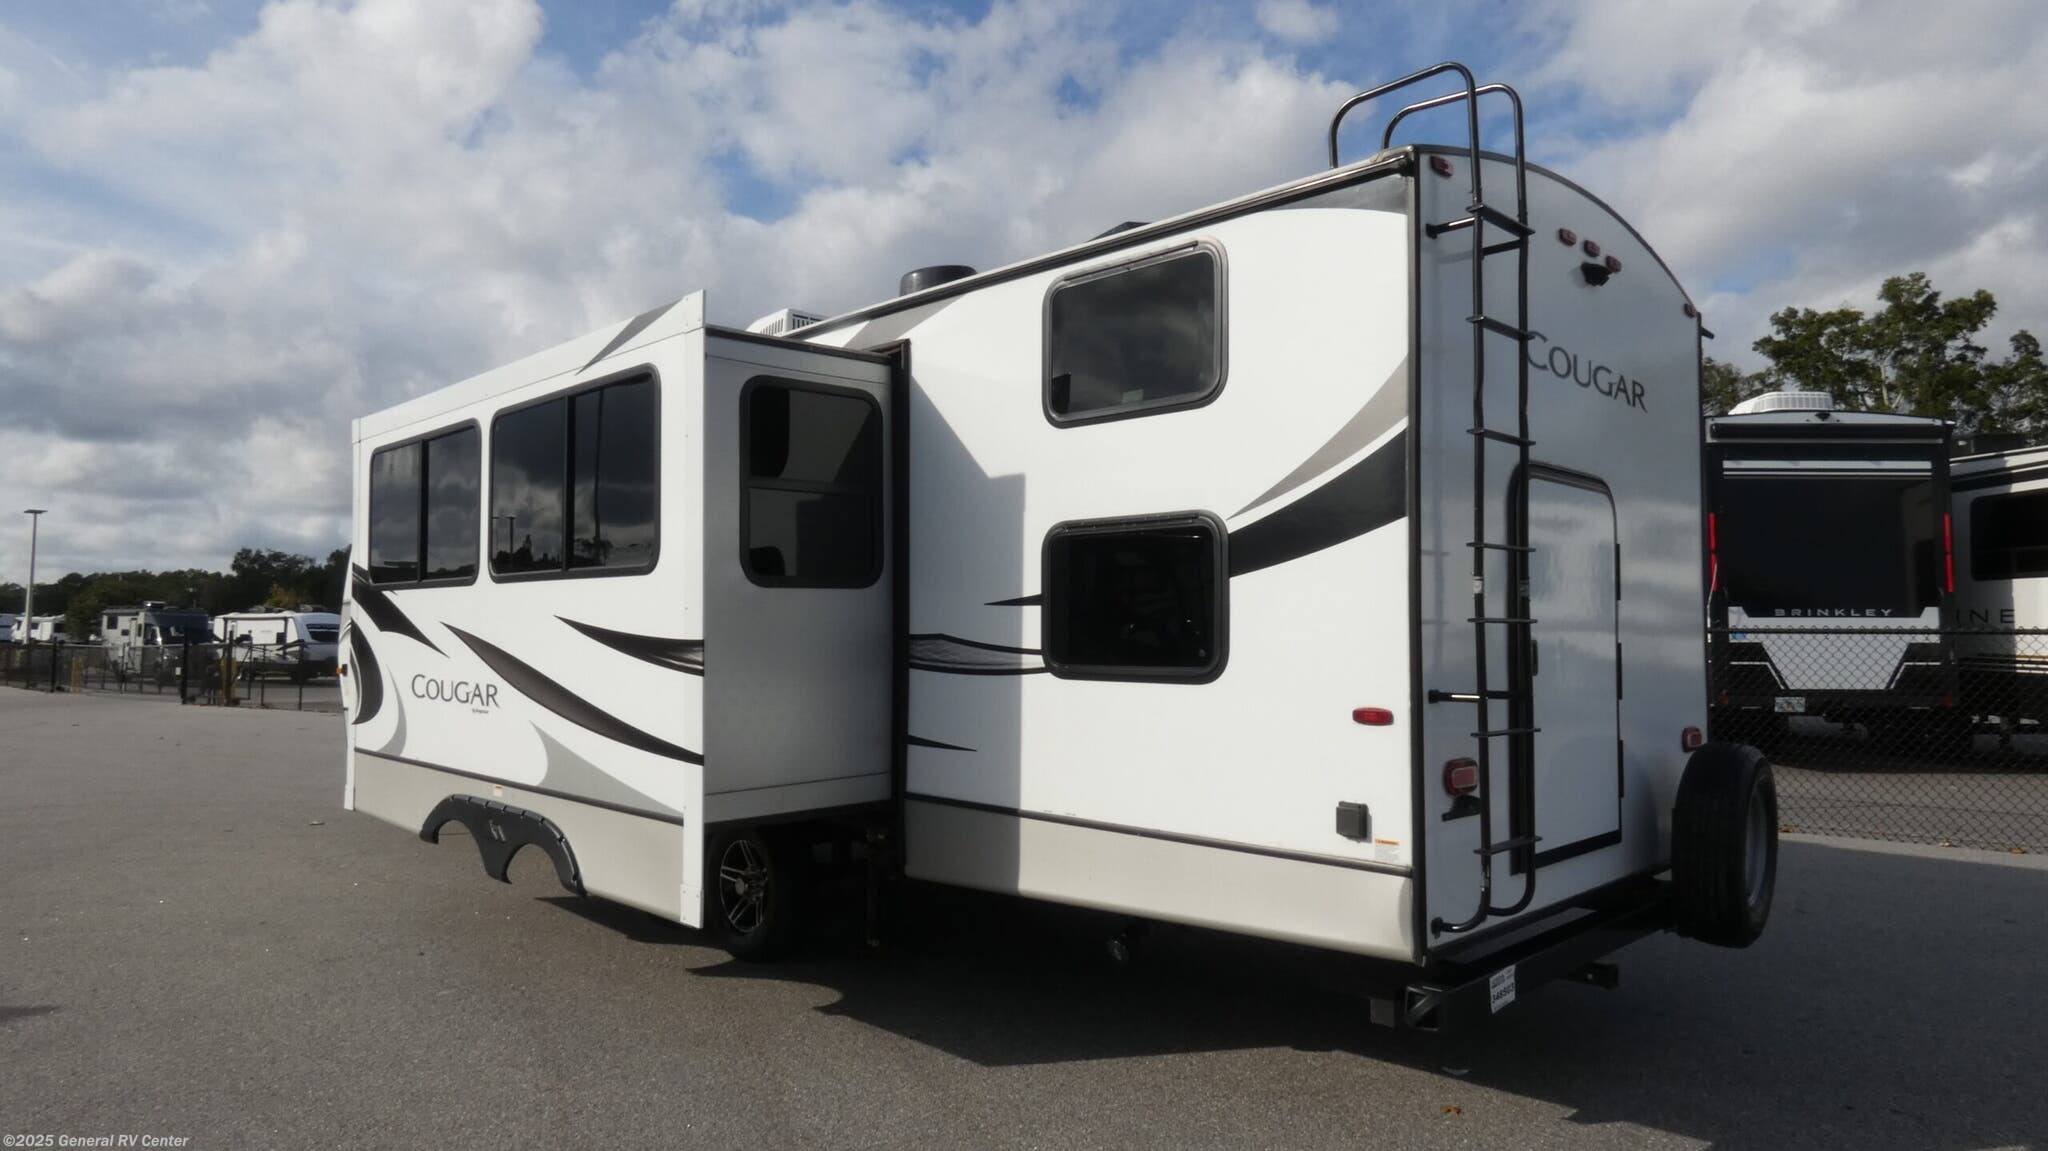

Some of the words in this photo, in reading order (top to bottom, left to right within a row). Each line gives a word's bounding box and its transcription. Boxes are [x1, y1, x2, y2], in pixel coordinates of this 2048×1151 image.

[1526, 331, 1647, 413] COUGAR
[1774, 608, 1892, 616] BRINKLEY
[411, 674, 500, 708] COUGAR
